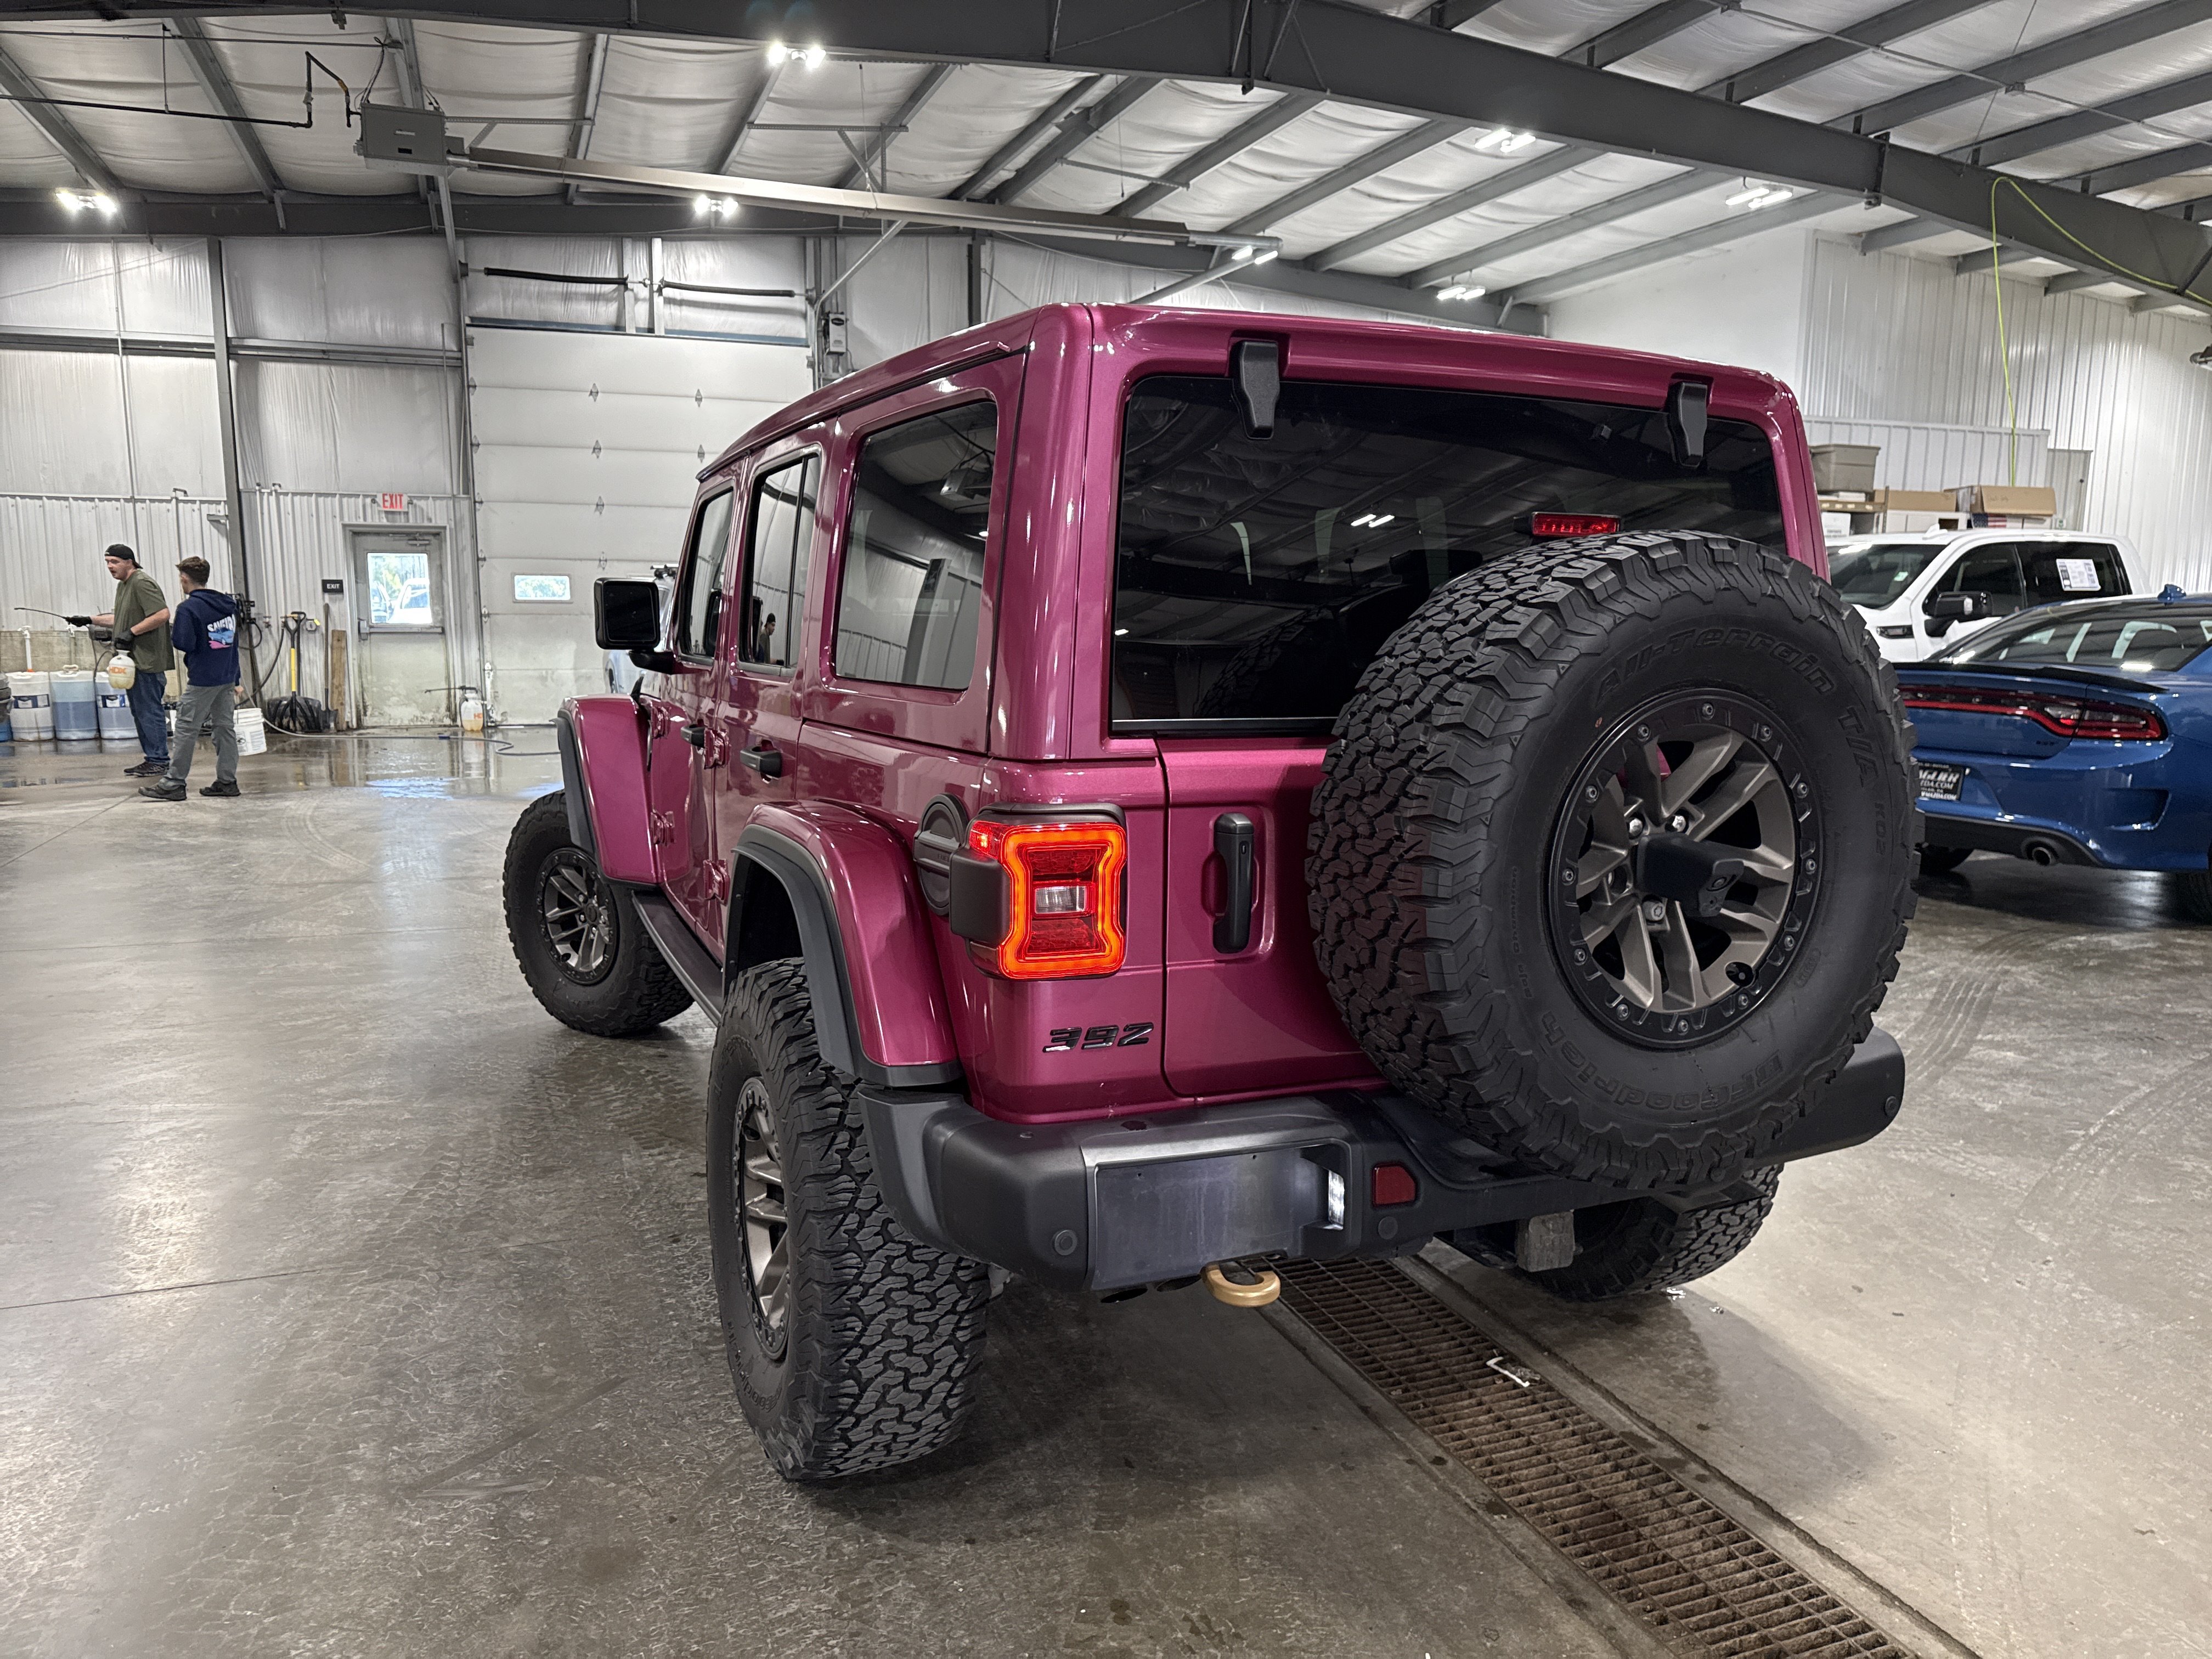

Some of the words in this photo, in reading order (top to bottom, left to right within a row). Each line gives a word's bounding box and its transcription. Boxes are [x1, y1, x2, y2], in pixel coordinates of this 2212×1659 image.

[382, 493, 403, 509] EXIT
[1596, 627, 1836, 702] All-Terrain
[937, 854, 950, 862] FUE
[1042, 1022, 1154, 1053] 392
[1541, 1011, 1785, 1111] BFGoodrich
